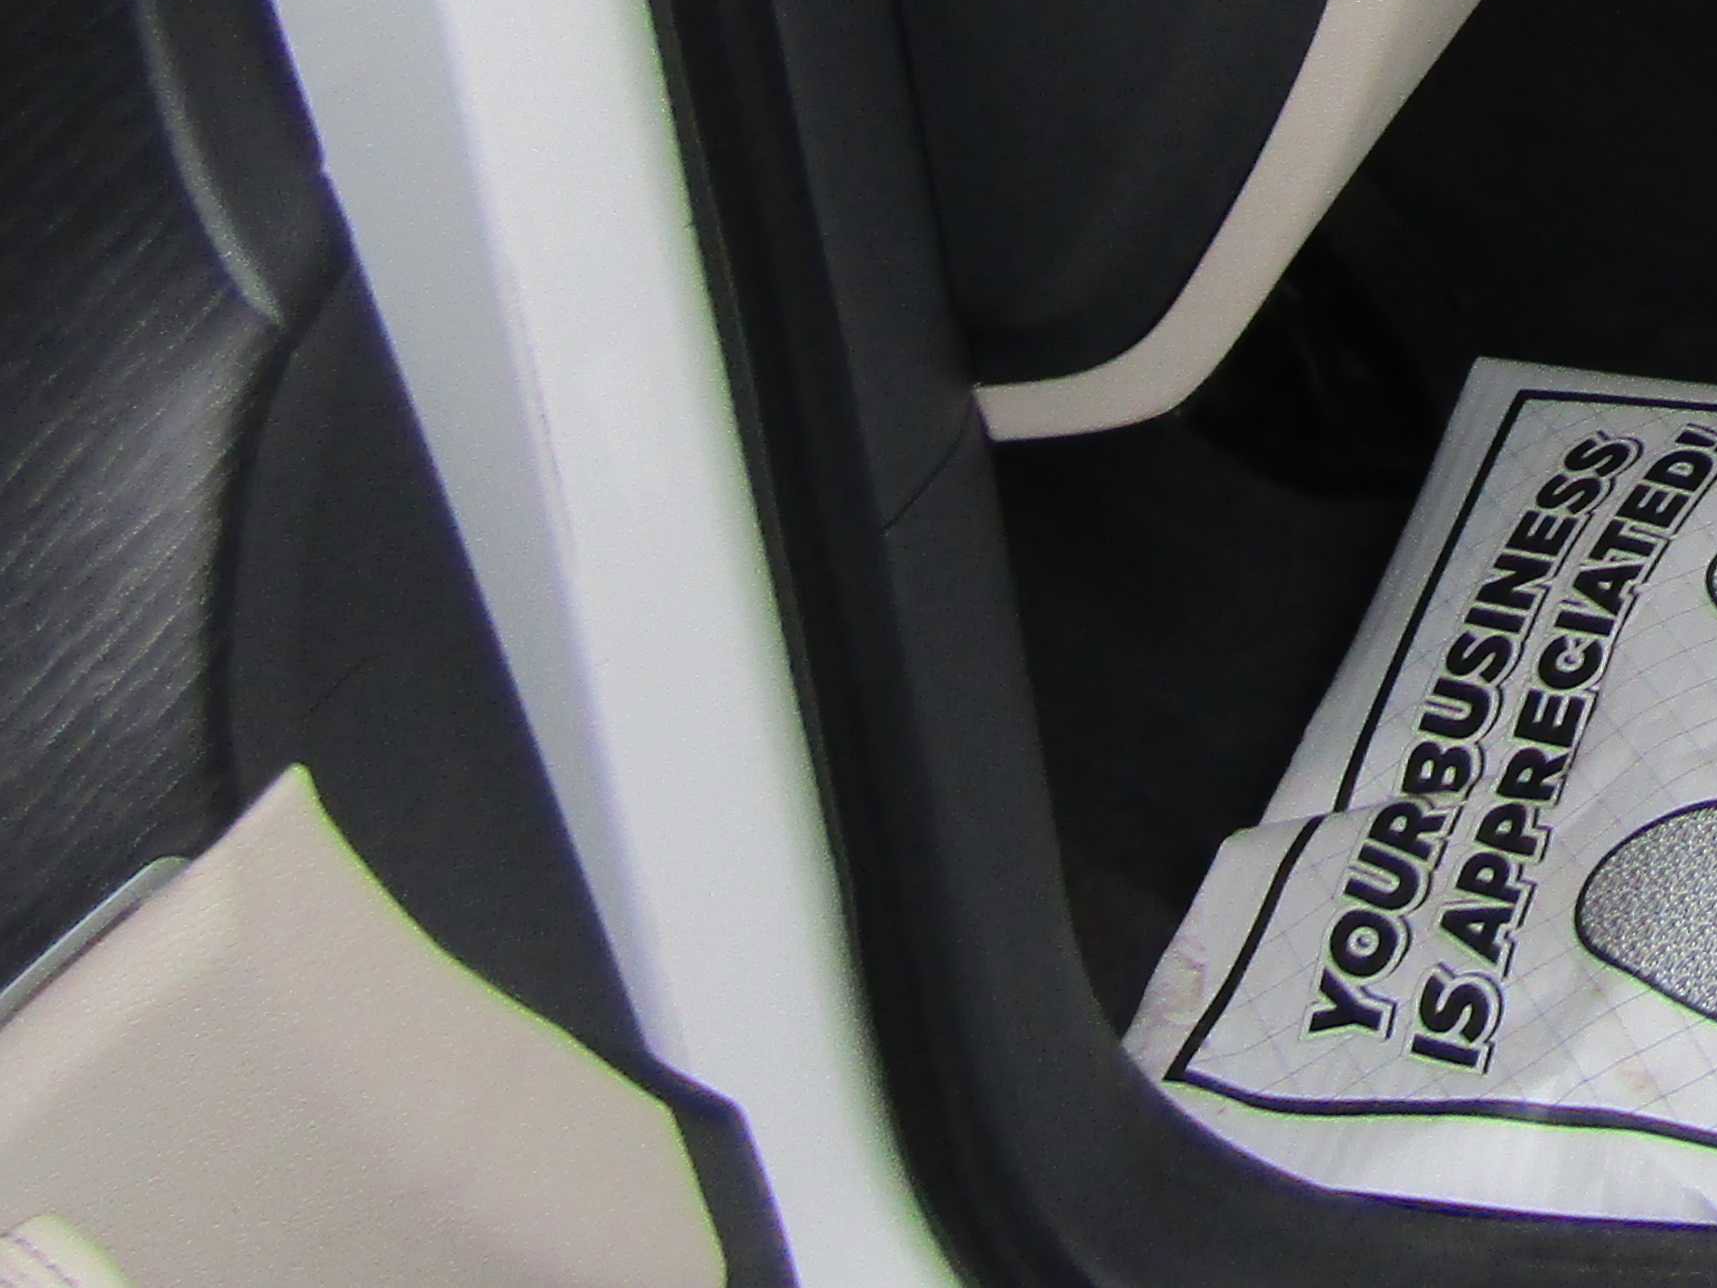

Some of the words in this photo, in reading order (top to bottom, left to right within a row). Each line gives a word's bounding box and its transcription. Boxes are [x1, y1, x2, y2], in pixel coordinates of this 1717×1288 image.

[1304, 796, 1453, 1039] YOUR
[1402, 430, 1642, 806] BUSINESS
[1409, 964, 1500, 1074] IS
